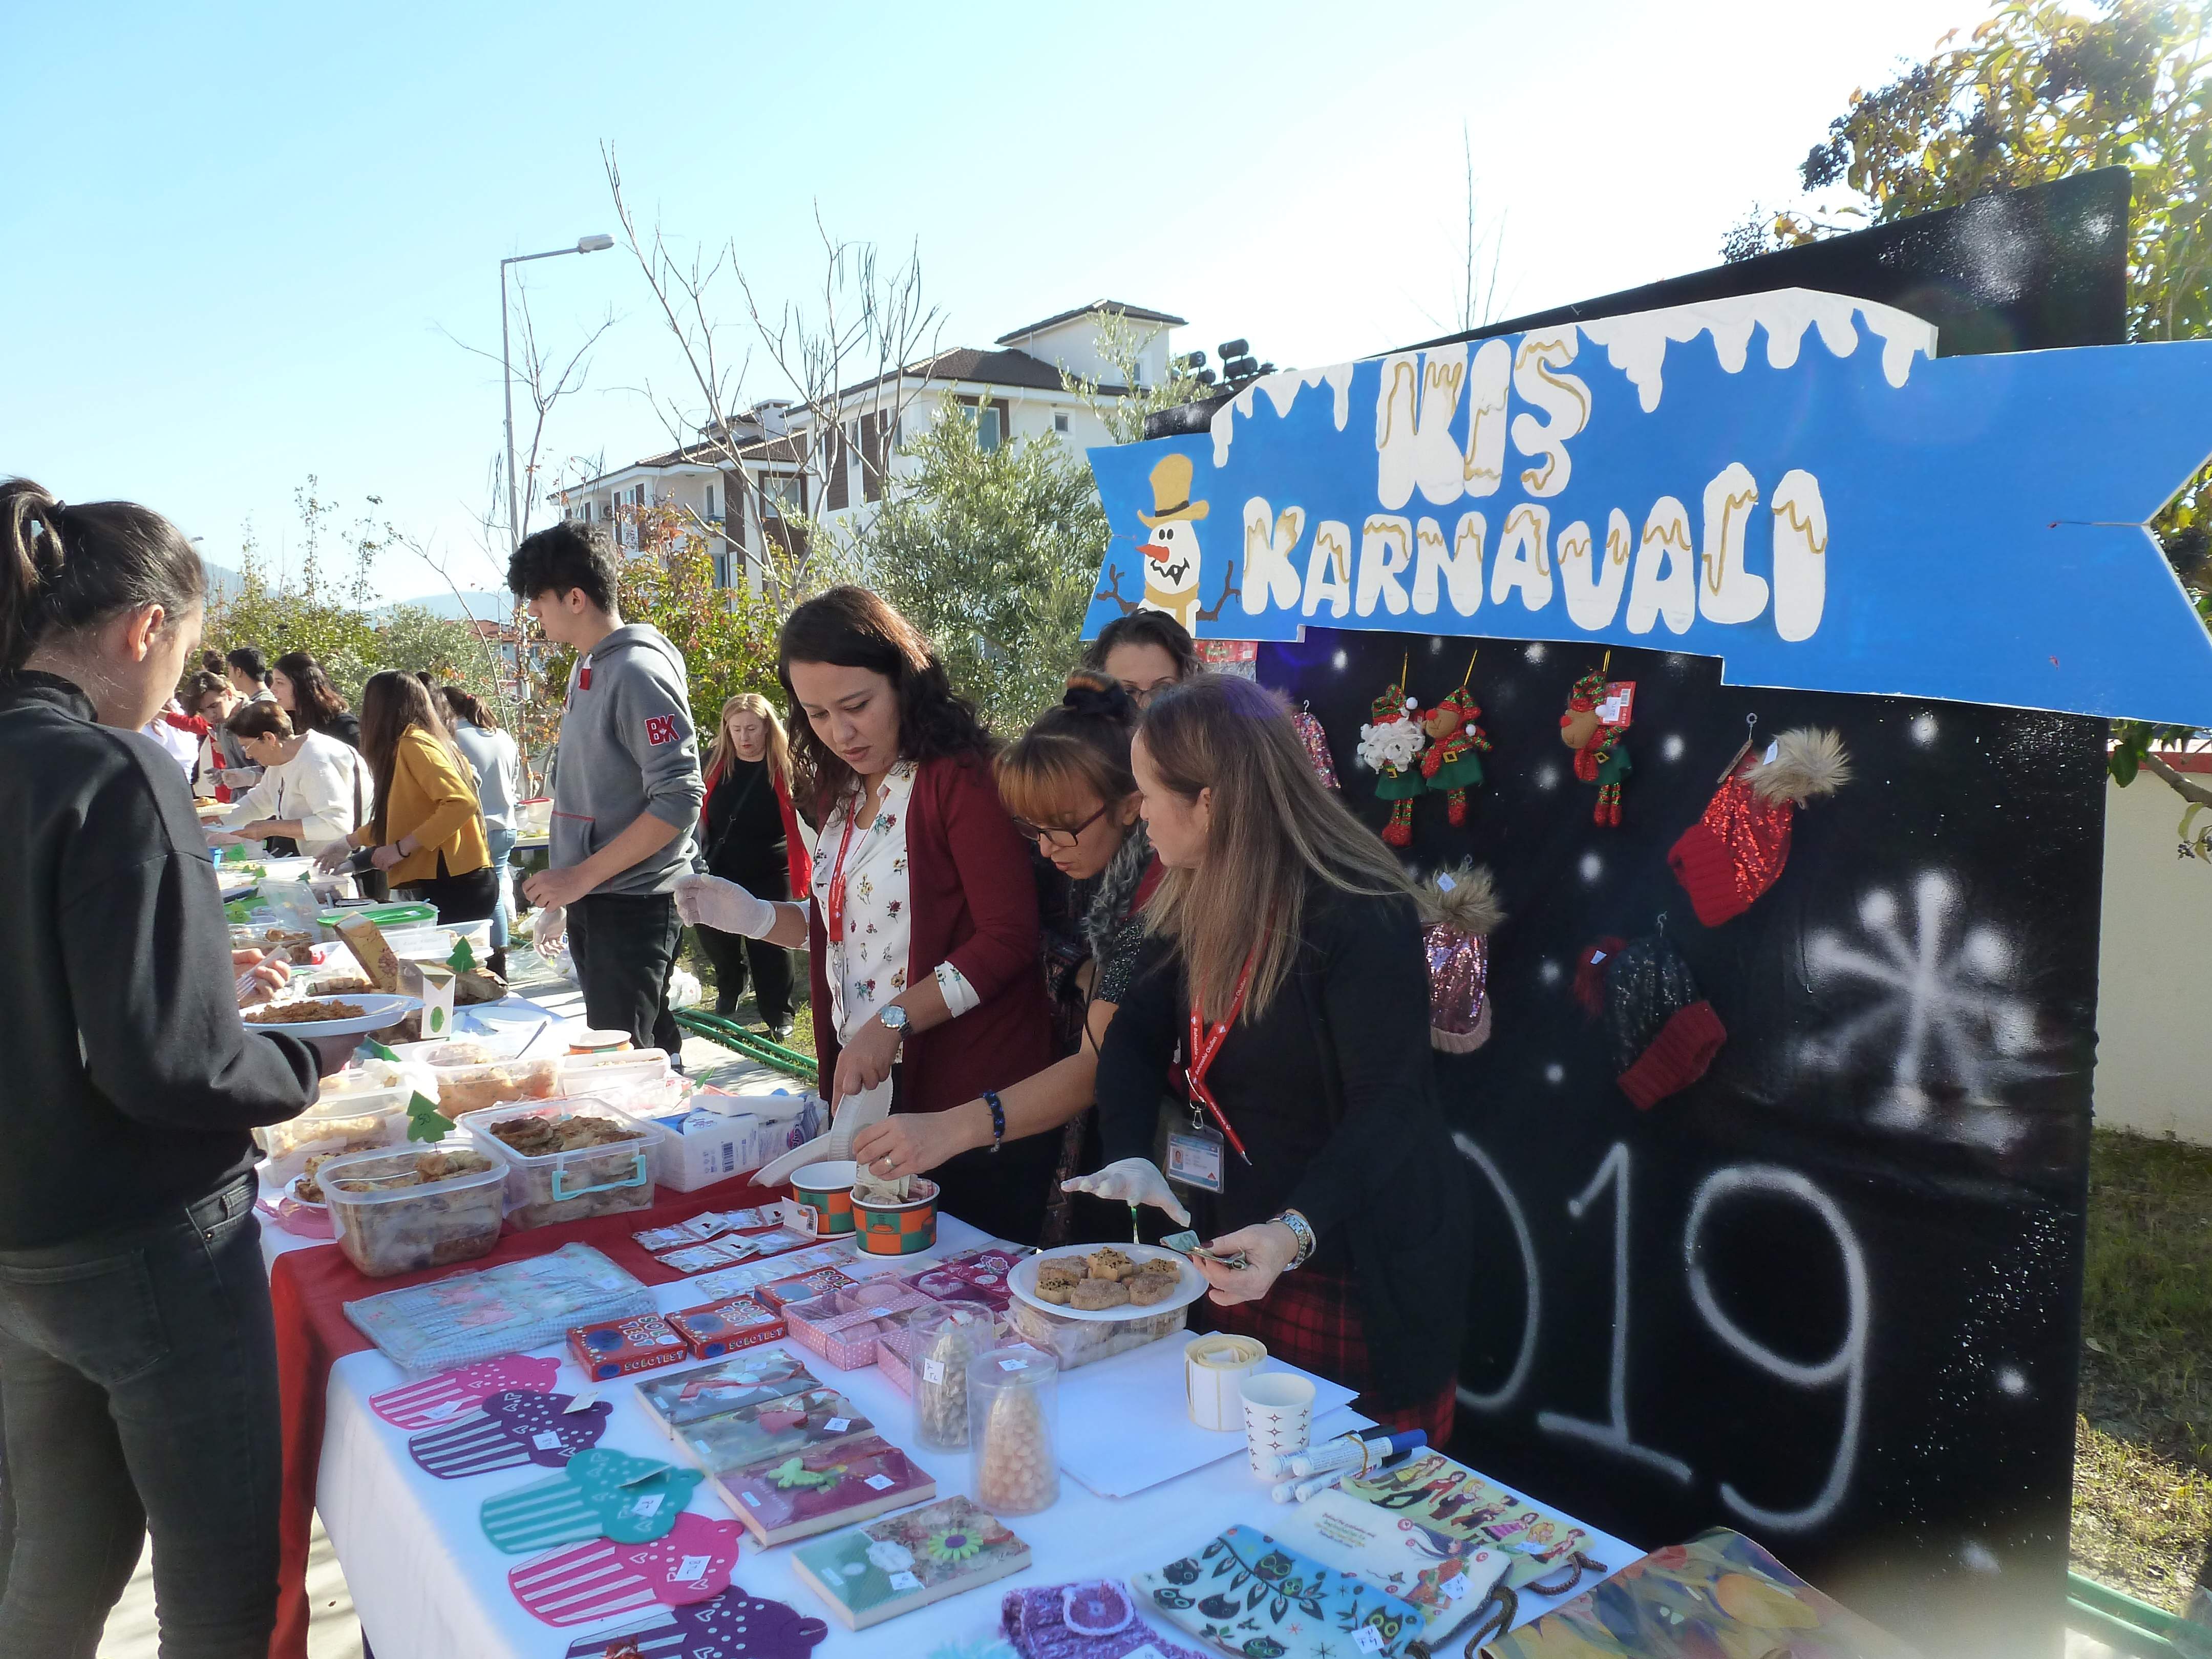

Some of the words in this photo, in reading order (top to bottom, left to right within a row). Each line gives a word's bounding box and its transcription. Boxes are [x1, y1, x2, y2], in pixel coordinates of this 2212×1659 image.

[1376, 323, 1591, 510] KIŞ
[1242, 462, 1828, 642] KARNAVALI
[645, 714, 680, 746] BK
[619, 1321, 655, 1347] TEST
[729, 1327, 783, 1350] SOLOTEST
[625, 1350, 684, 1371] SOLOTEST
